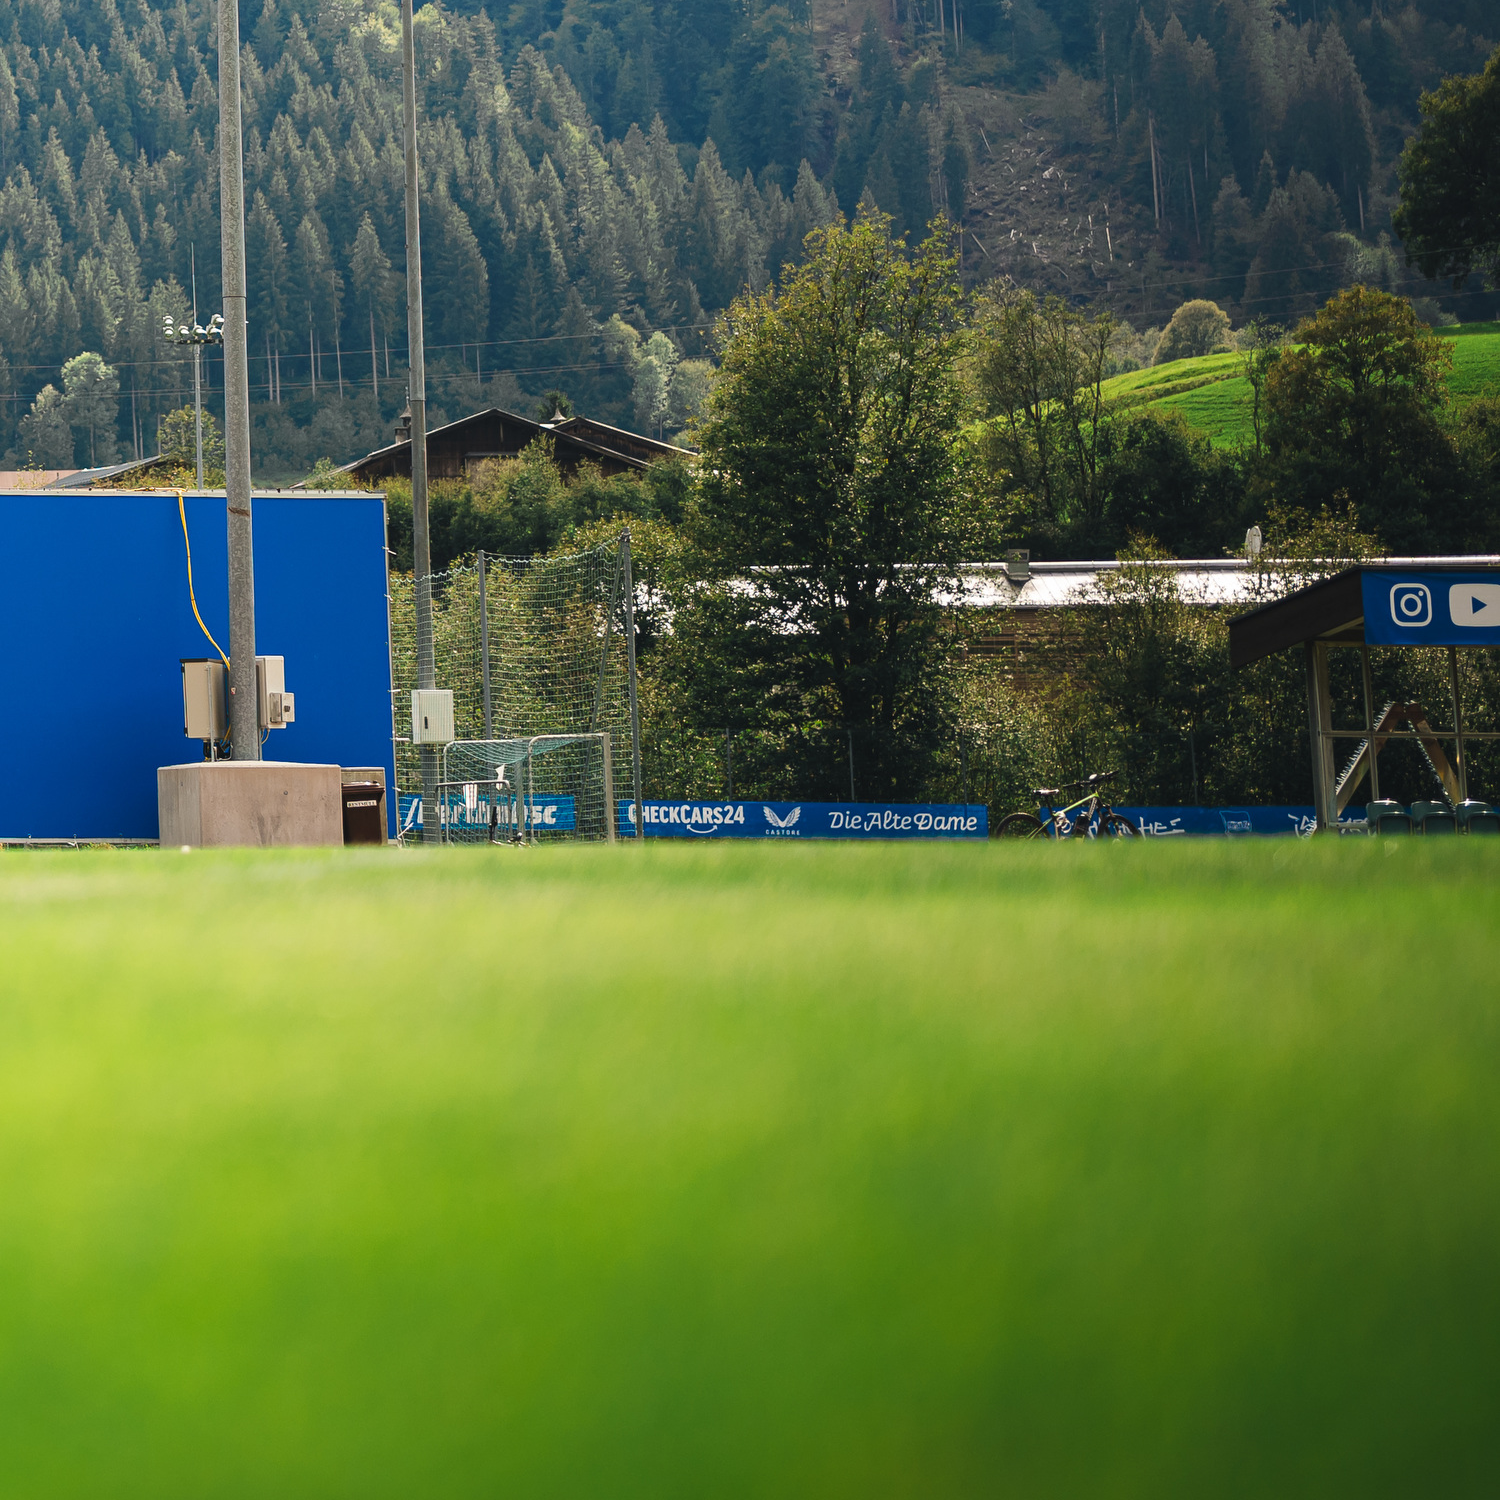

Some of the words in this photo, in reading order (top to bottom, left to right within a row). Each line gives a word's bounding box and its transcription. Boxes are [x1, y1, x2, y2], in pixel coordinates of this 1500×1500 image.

[828, 811, 862, 829] Die
[864, 810, 912, 832] Alte
[913, 813, 978, 831] Dame
